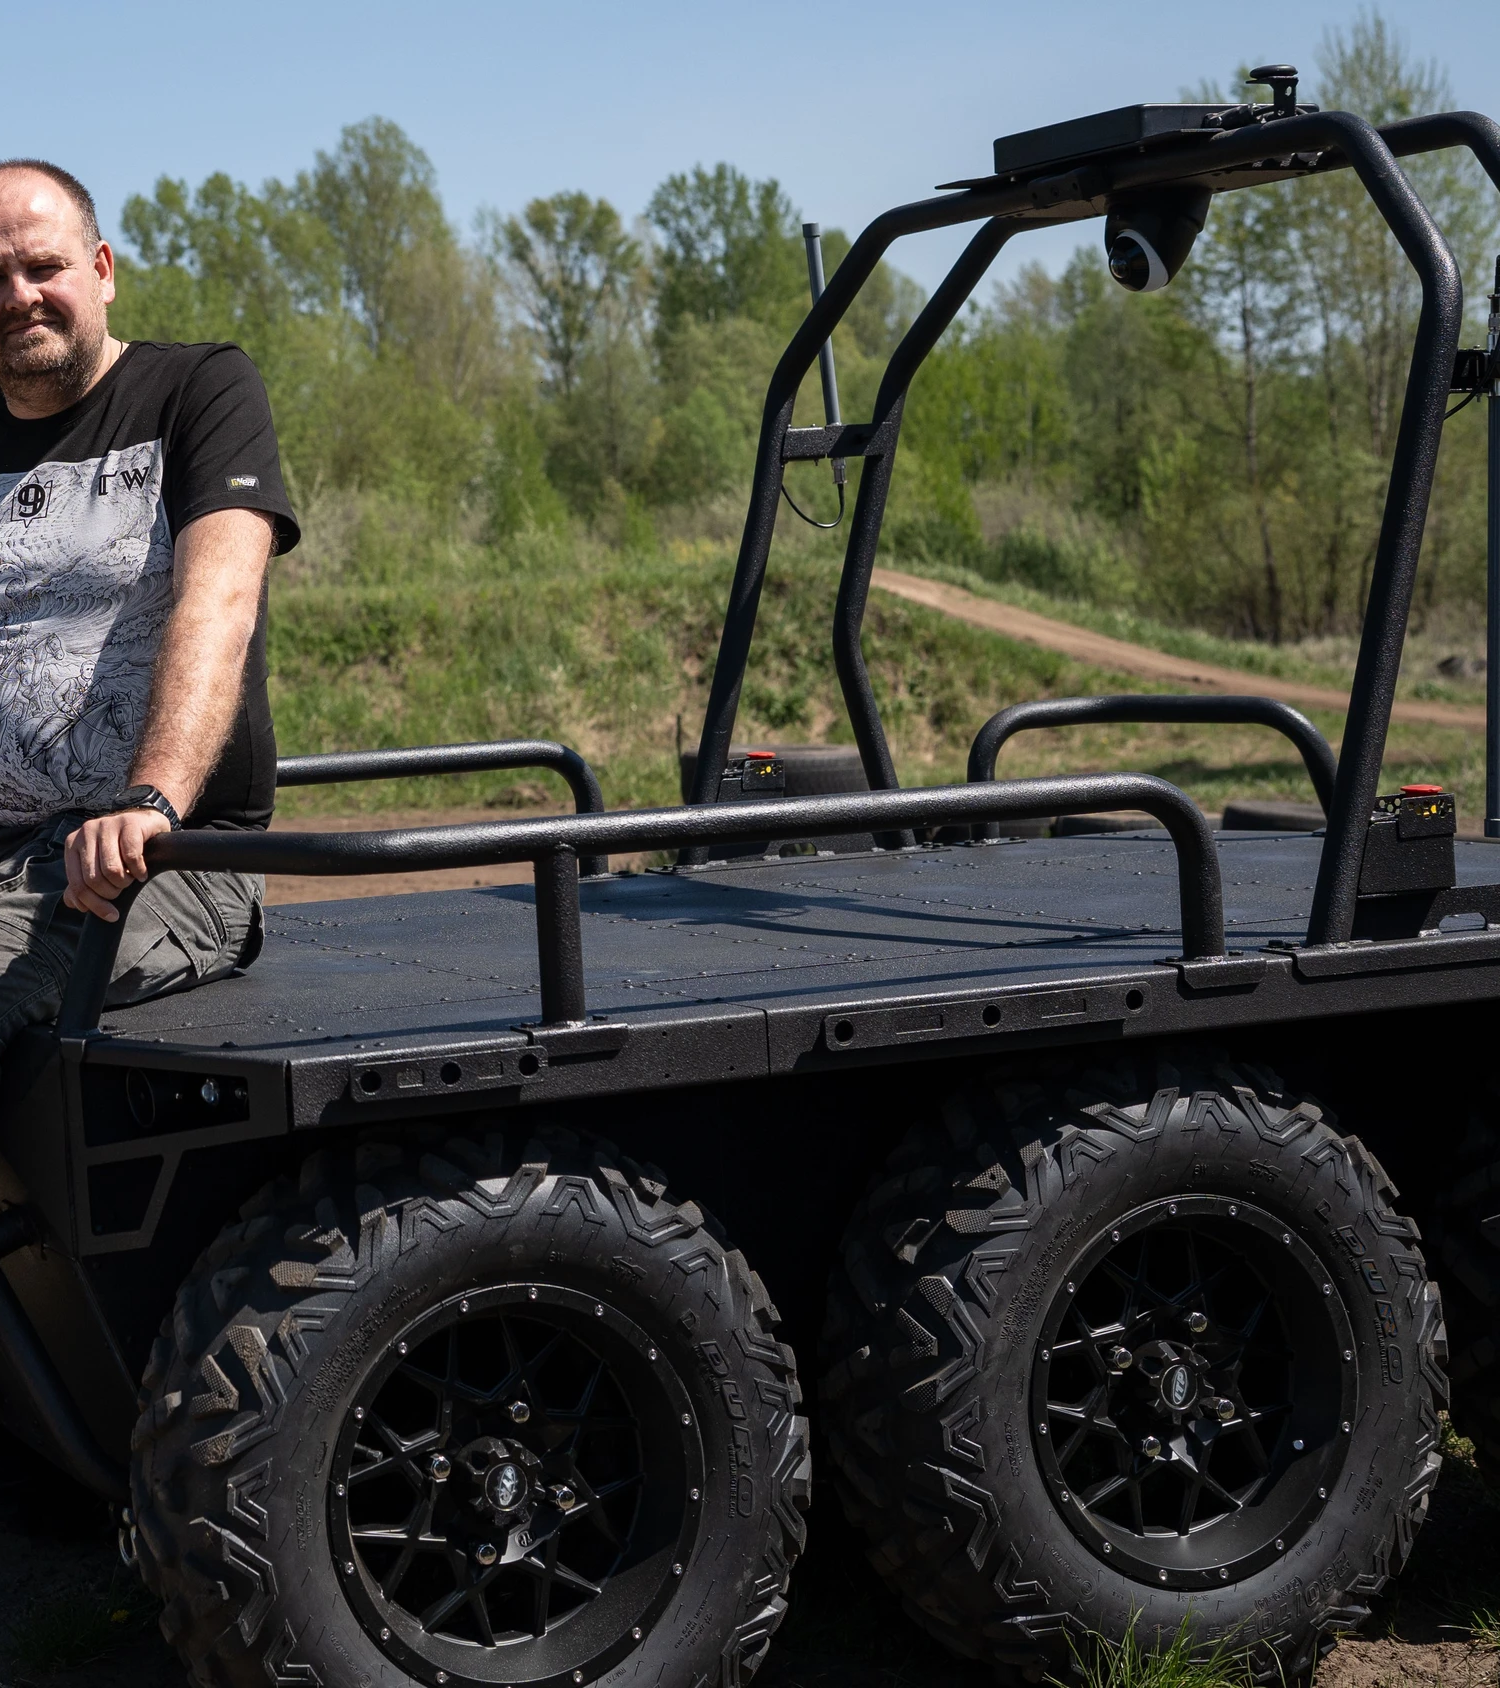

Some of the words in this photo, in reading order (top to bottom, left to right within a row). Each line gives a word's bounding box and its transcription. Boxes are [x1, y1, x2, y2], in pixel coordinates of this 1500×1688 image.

[1336, 1224, 1404, 1384] DURO
[699, 1340, 754, 1518] DURO
[1174, 1370, 1186, 1402] ITP
